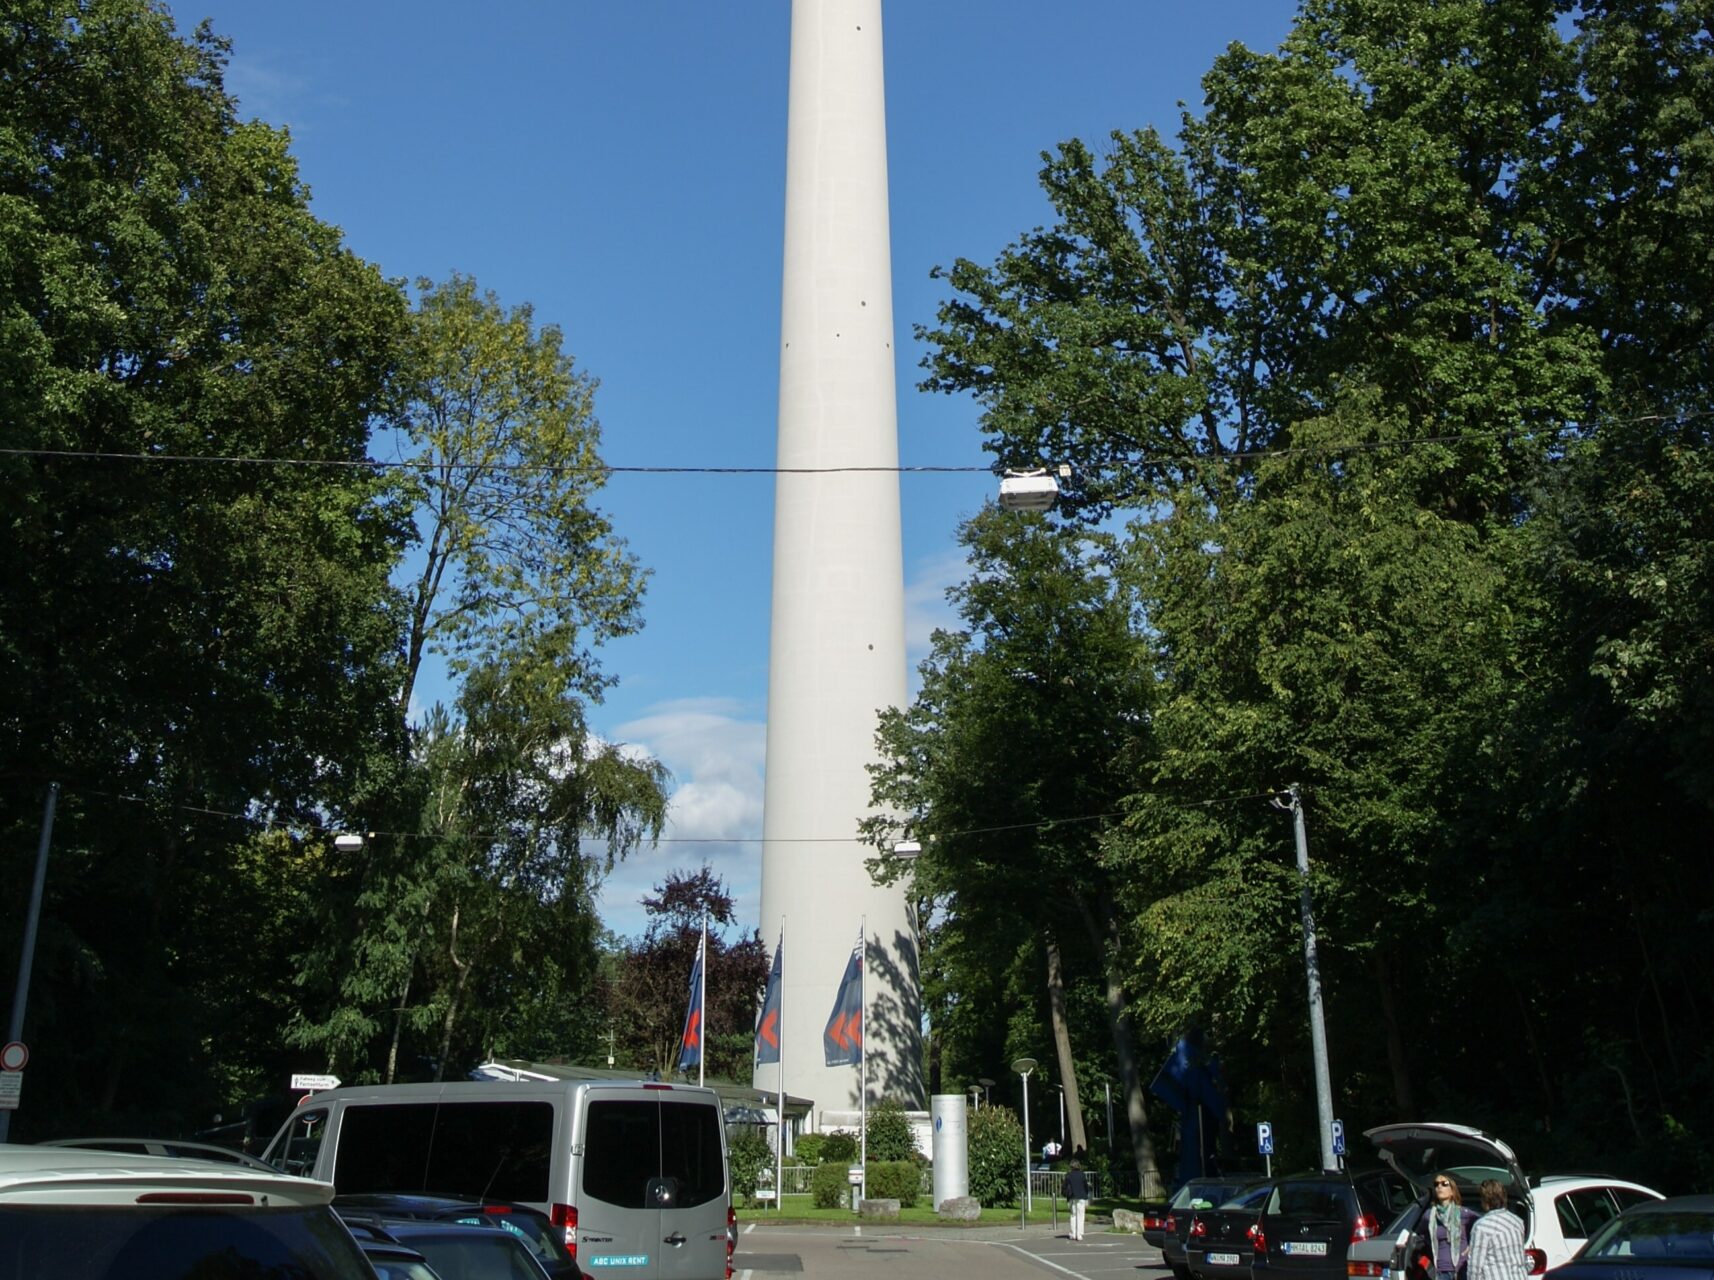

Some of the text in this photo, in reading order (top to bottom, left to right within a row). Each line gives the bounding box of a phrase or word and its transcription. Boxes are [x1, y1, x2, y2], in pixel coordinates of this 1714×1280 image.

[1259, 1125, 1269, 1146] P
[1332, 1122, 1342, 1146] P
[593, 1256, 646, 1265] ABC UNIX RENT
